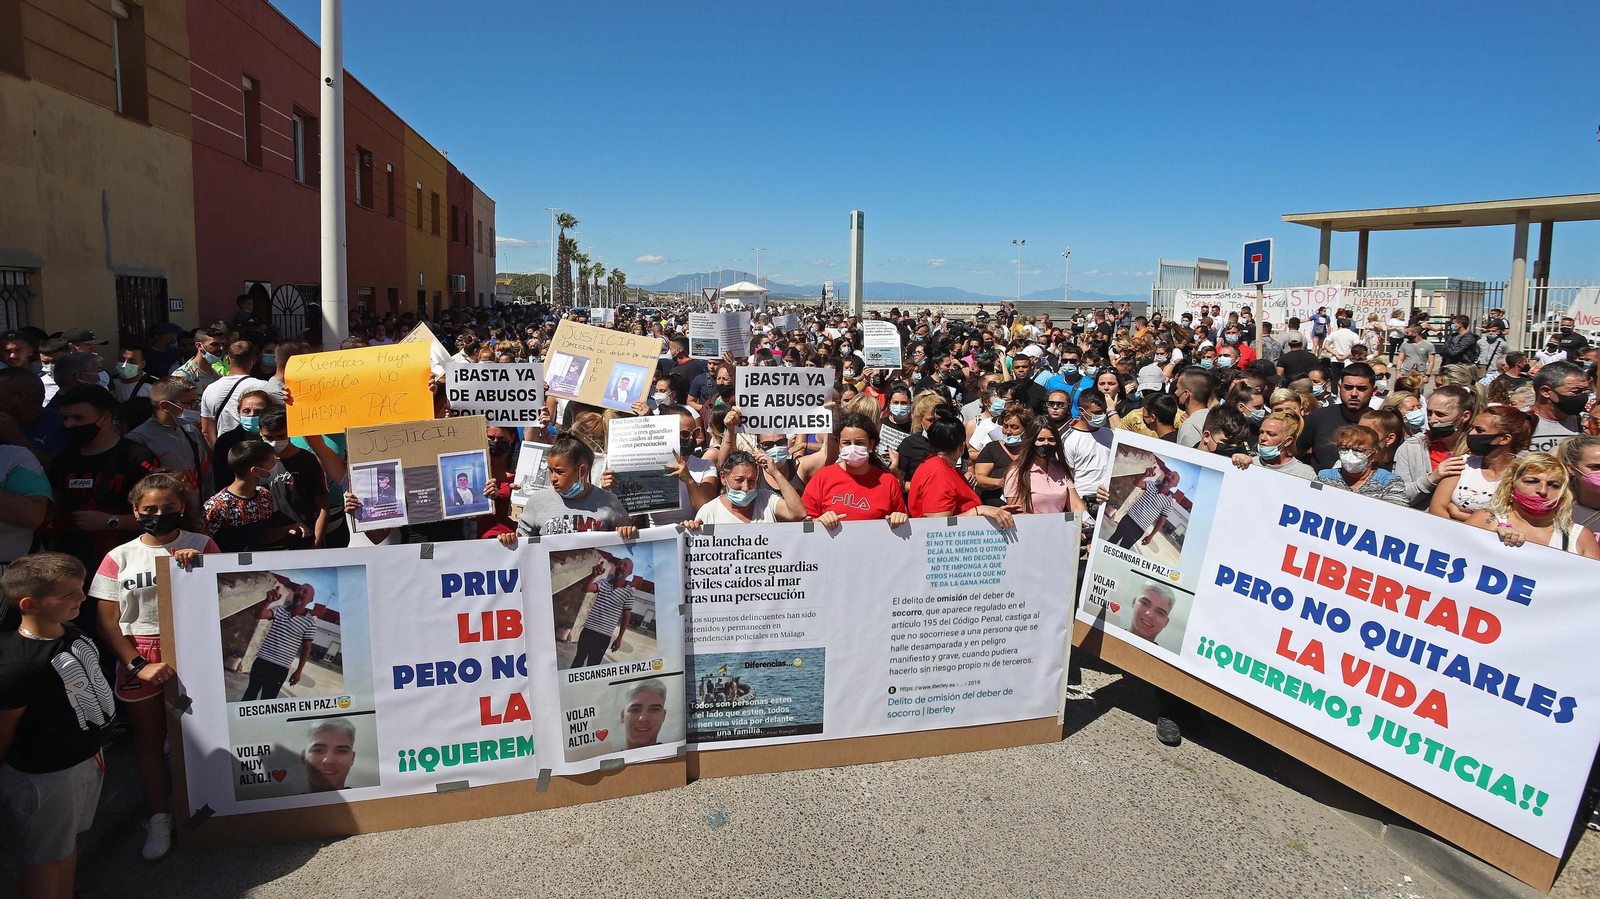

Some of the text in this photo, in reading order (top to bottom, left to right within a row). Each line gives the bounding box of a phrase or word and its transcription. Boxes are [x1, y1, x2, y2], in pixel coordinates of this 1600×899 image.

[1291, 287, 1337, 306] STOP
[1353, 298, 1399, 307] LIBERTAD
[562, 325, 636, 347] JUSTICIA
[295, 352, 410, 373] Mientras Haya
[375, 372, 398, 387] NO
[454, 369, 535, 383] ¡BASTA YA
[745, 373, 825, 388] ¡BASTA YA
[450, 389, 536, 402] DE ABUSOS
[739, 394, 824, 407] DE ABUSOS
[298, 393, 408, 426] HABRÁ PAZ
[739, 415, 829, 429] POLICIALES!
[358, 425, 457, 455] JUSTICIA
[831, 493, 870, 510] FILA
[685, 535, 769, 548] Una lancha de
[685, 549, 782, 562] narcotraficantes
[1103, 545, 1169, 578] DESCANSAR EN PAZ.!
[1279, 504, 1536, 606] PRIVARLES DE
[744, 564, 766, 574] tres
[768, 561, 818, 576] guardias
[441, 568, 522, 598] PRIV
[685, 576, 801, 590] civiles caídos al mar
[1093, 573, 1115, 589] VOLAR
[685, 589, 805, 604] tras una persecución
[892, 590, 1015, 606] El delito de omisión del deber de
[1093, 585, 1107, 597] MUY
[1280, 544, 1502, 644] LIBERTAD
[891, 609, 925, 619] socorro,
[925, 608, 940, 617] que
[941, 606, 973, 616] aparece
[973, 602, 1007, 614] regulado
[1018, 600, 1026, 609] el
[704, 615, 739, 624] supuestos
[741, 612, 785, 621] delincuentes
[1215, 564, 1578, 723] PERO NO QUITARLES
[889, 647, 1018, 664] manifiesto y grave, cuando pudiera
[569, 662, 651, 682] DESCANSAR EN PAZ.!
[745, 660, 793, 669] Diferencias...
[393, 658, 482, 690] PERO
[1276, 627, 1448, 729] LA VIDA
[732, 699, 768, 707] personas
[887, 687, 1014, 707] Delito de omisión del deber de
[239, 698, 337, 717] DESCANSAR EN PAZ.!
[480, 692, 532, 726] LA
[566, 707, 595, 721] VOLAR
[742, 708, 766, 716] esten,
[886, 705, 956, 719] socorro Iberley
[570, 722, 588, 734] MUY
[1197, 636, 1549, 816] ¡¡QUEREMOS JUSTICIA!!
[569, 733, 595, 748] ALTO.!
[237, 745, 271, 758] VOLAR
[241, 759, 263, 771] MUY
[239, 771, 271, 786] ALTO.!
